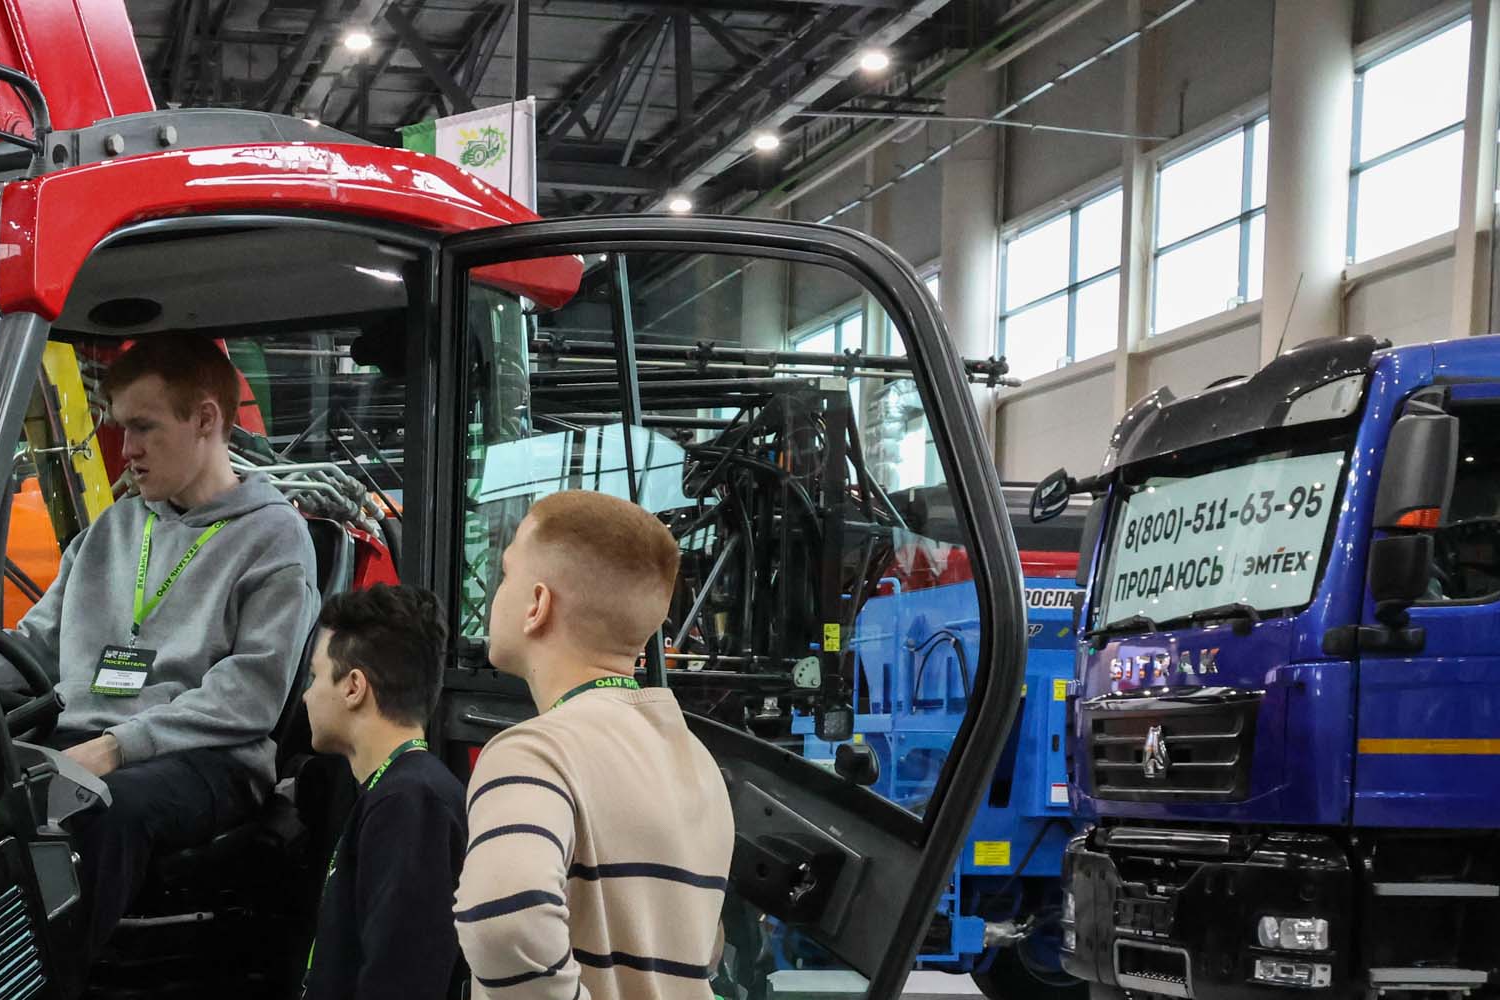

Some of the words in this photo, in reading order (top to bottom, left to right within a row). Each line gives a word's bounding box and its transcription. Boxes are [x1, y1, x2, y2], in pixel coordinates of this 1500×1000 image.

[1124, 483, 1326, 552] 8(800)-511-63-95
[156, 577, 173, 597] АГРО
[1114, 555, 1224, 602] ПРОДАЮСЬ
